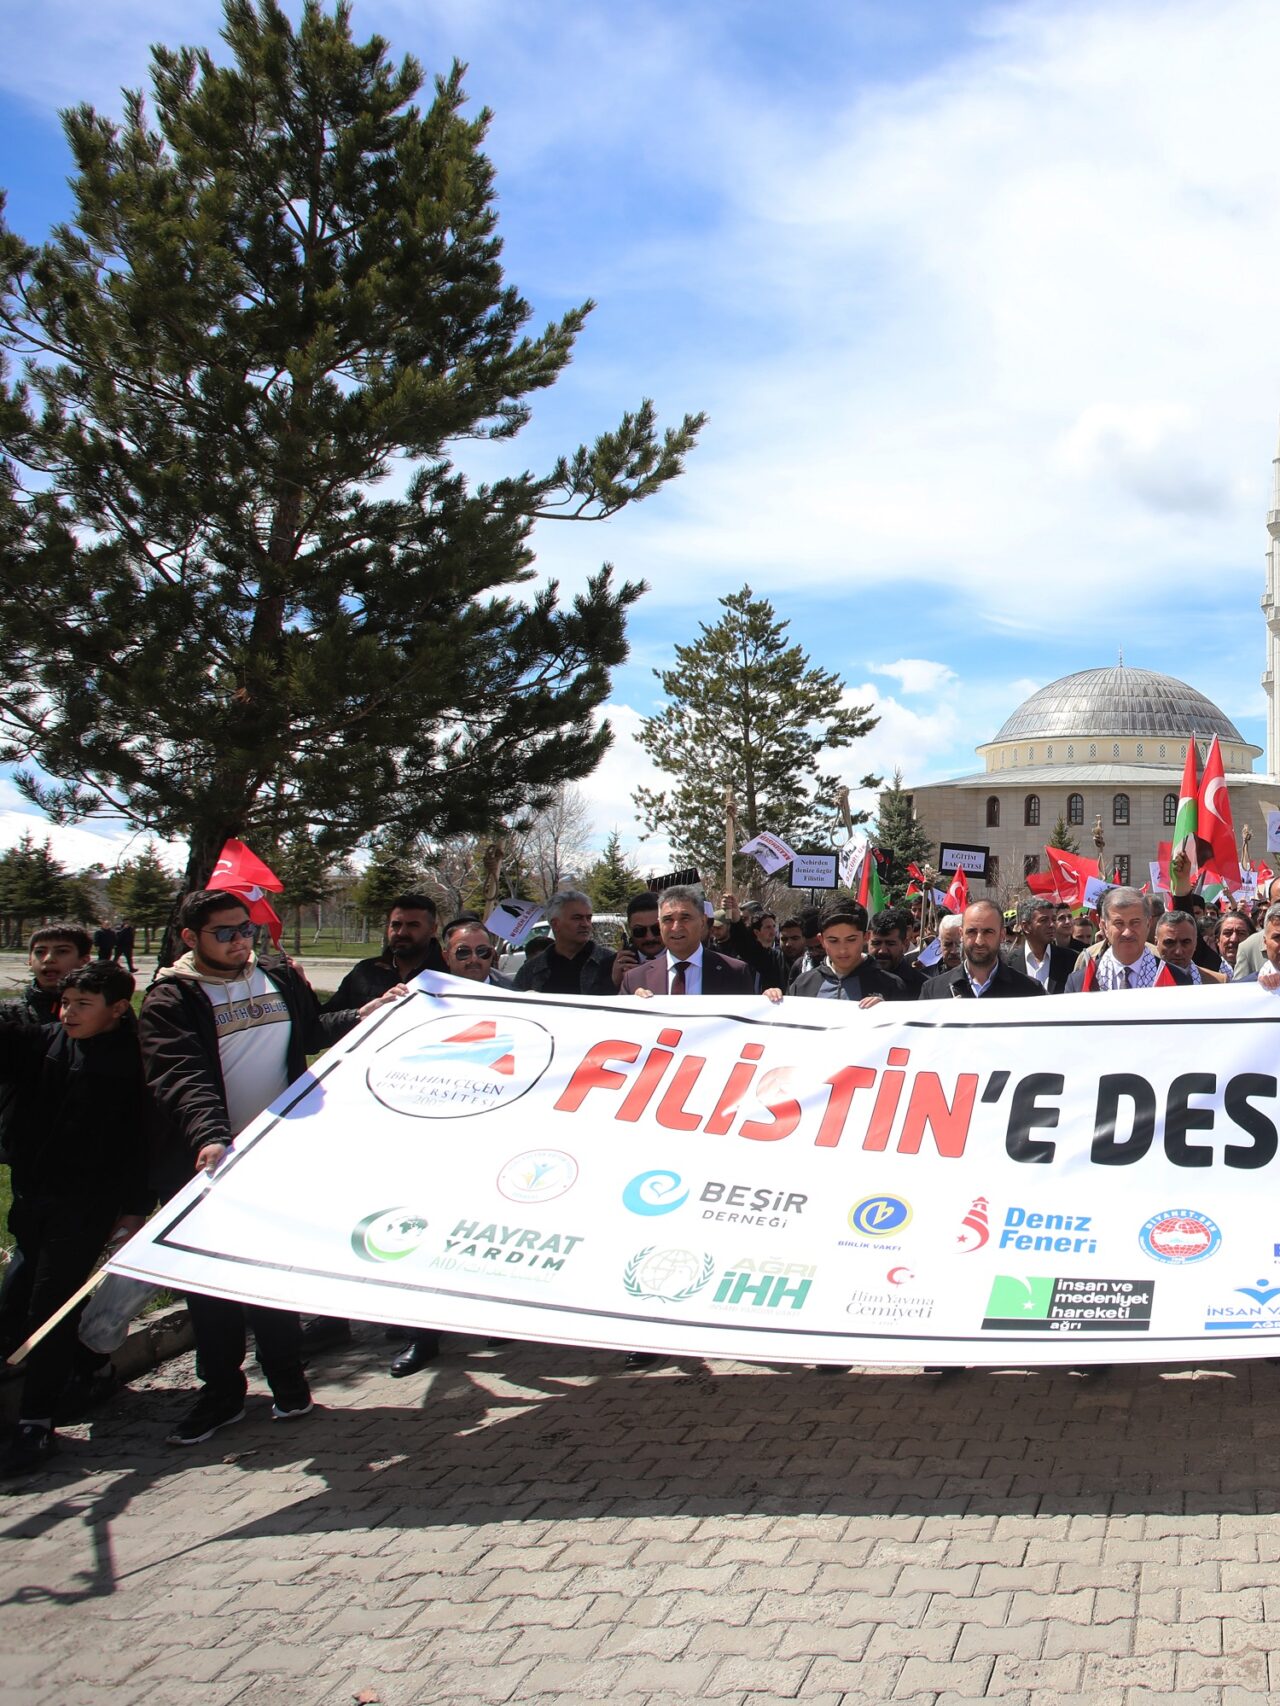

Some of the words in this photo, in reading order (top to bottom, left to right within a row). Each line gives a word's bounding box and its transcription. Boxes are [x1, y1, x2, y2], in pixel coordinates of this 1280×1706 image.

[944, 861, 982, 870] FAKLTESİ
[553, 1028, 1065, 1164] FİLİSTİN'E
[1004, 1207, 1092, 1231] Deniz
[450, 1219, 584, 1255] HAYRAT
[999, 1229, 1097, 1254] Feneri
[444, 1239, 566, 1272] YARDIM
[730, 1256, 818, 1278] AĞRI
[1057, 1279, 1108, 1292] insan
[1111, 1282, 1134, 1292] ve
[1055, 1292, 1149, 1308] medeniyet
[846, 1302, 933, 1321] Cemiyeti
[1051, 1306, 1130, 1319] hareketi
[1207, 1305, 1262, 1317] İNSAN
[1050, 1320, 1082, 1332] ağrı
